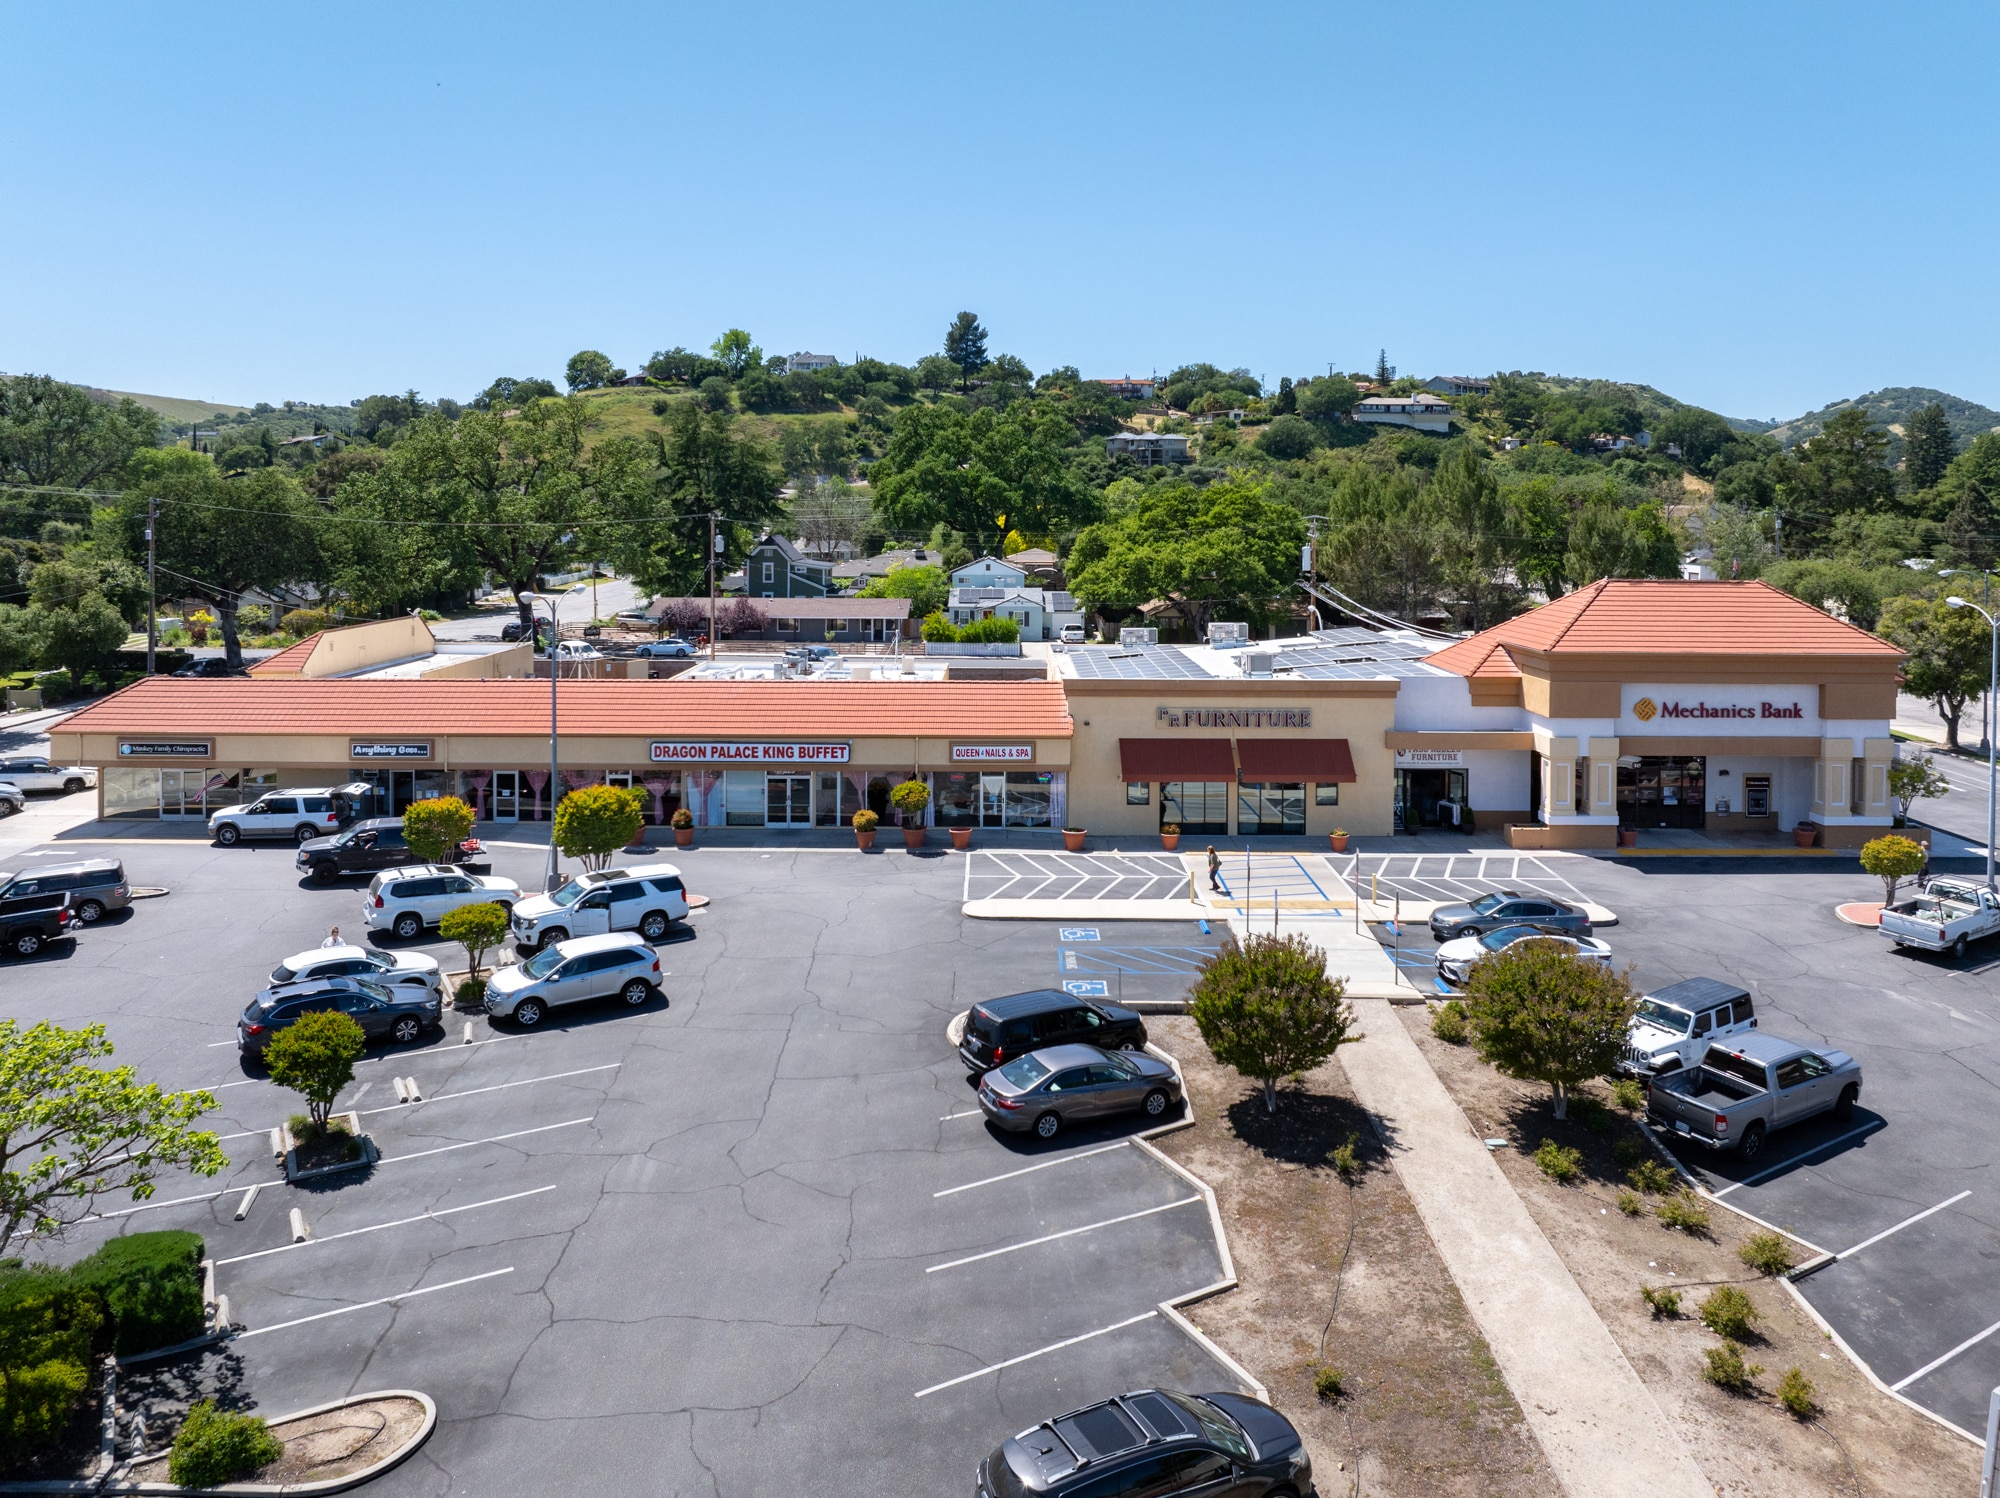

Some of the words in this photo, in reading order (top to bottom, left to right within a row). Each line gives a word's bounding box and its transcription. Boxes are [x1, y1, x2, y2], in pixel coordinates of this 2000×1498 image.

[1661, 702, 1756, 719] Mechanics
[1761, 702, 1804, 719] Bank
[1182, 709, 1312, 728] FURNITURE
[154, 745, 172, 753] Family
[172, 745, 206, 753] Chiropractic
[354, 745, 397, 756] Anything
[653, 745, 707, 758] DRAGON
[711, 746, 759, 759] PALACE
[762, 746, 795, 759] KING
[798, 746, 847, 759] BUFFET
[955, 748, 980, 758] QUEEN
[985, 748, 1007, 758] NAILS
[1008, 748, 1014, 758] &
[1015, 748, 1030, 758] SPA
[1411, 753, 1458, 761] FURNITURE
